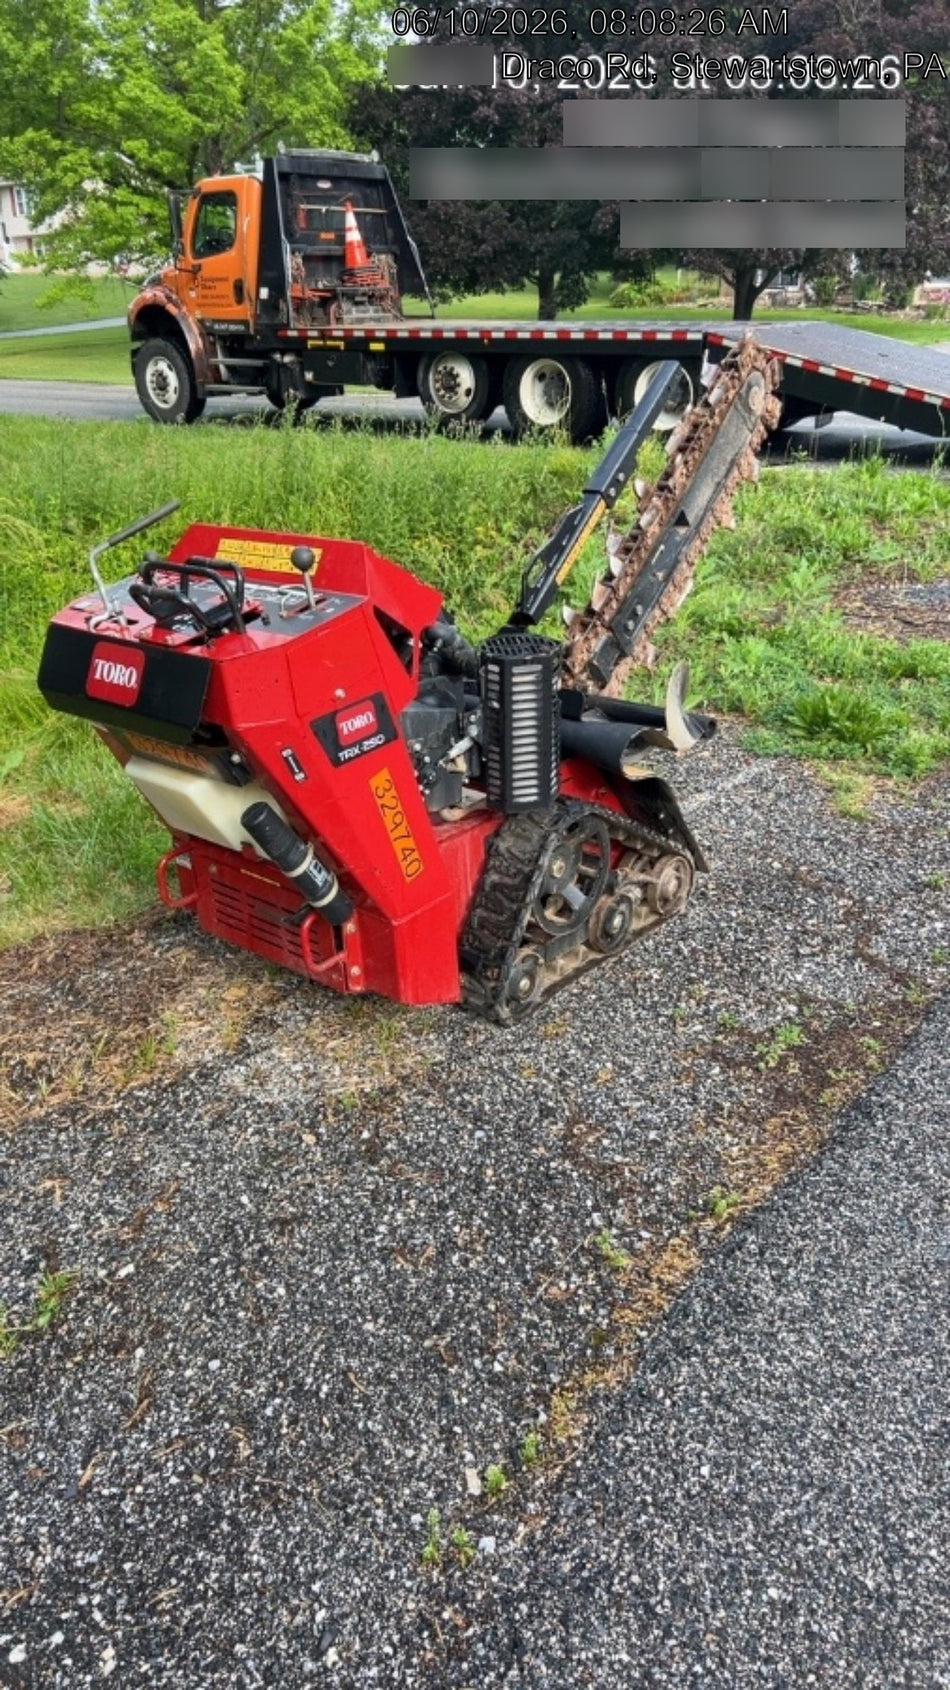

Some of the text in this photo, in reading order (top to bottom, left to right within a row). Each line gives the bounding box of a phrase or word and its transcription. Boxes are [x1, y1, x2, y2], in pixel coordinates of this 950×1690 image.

[93, 658, 139, 690] TORO
[339, 711, 376, 735] TORO
[375, 778, 422, 878] 329740
